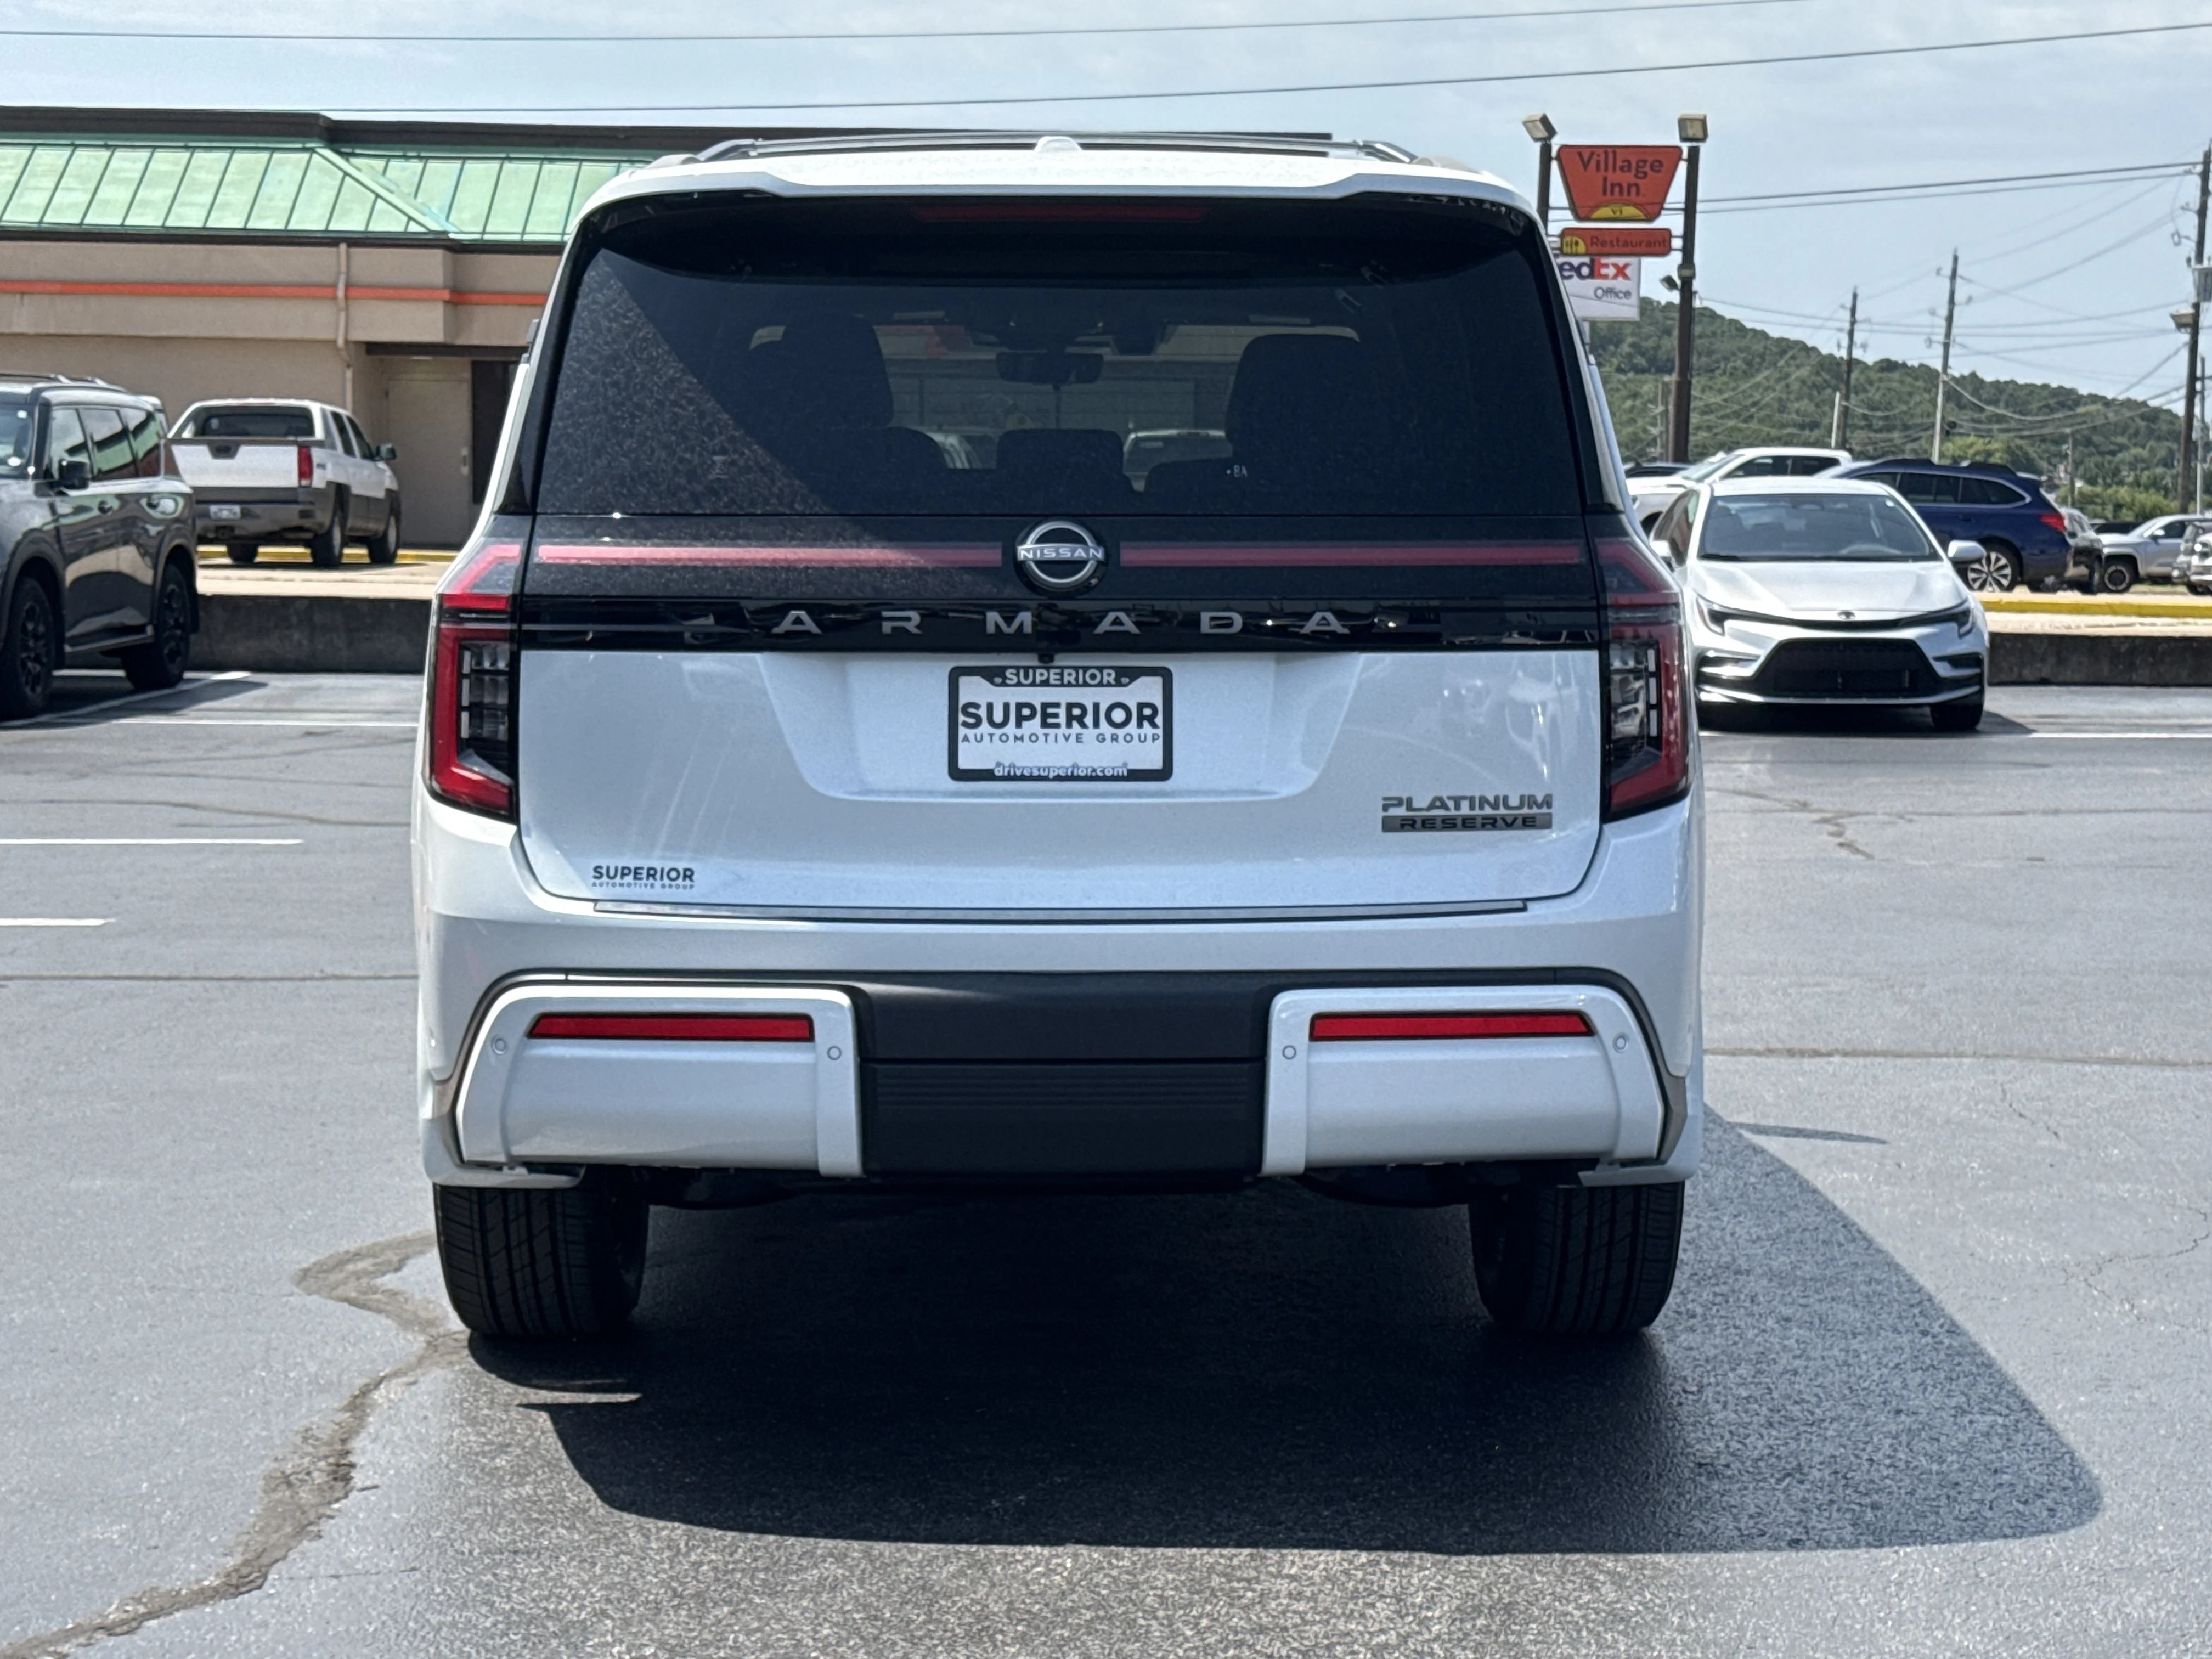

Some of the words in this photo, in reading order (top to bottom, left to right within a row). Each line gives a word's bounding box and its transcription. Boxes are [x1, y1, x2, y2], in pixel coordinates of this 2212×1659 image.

[1577, 149, 1664, 179] Village
[1602, 176, 1641, 197] Inn
[1591, 236, 1667, 248] Restaurant
[1554, 254, 1633, 280] edEx
[1594, 286, 1632, 299] Office
[1020, 548, 1102, 559] NISSAN
[771, 610, 1350, 635] ARMADA
[1005, 668, 1116, 685] SUPERIOR
[960, 702, 1160, 730] SUPERIOR
[961, 732, 1084, 744] AUTOMOTIVE
[1096, 732, 1160, 744] GROUP
[994, 761, 1128, 779] drivesuperior.com
[1381, 794, 1553, 812] PLATINUM
[1400, 816, 1537, 830] RESERVE
[592, 865, 695, 882] SUPERIOR
